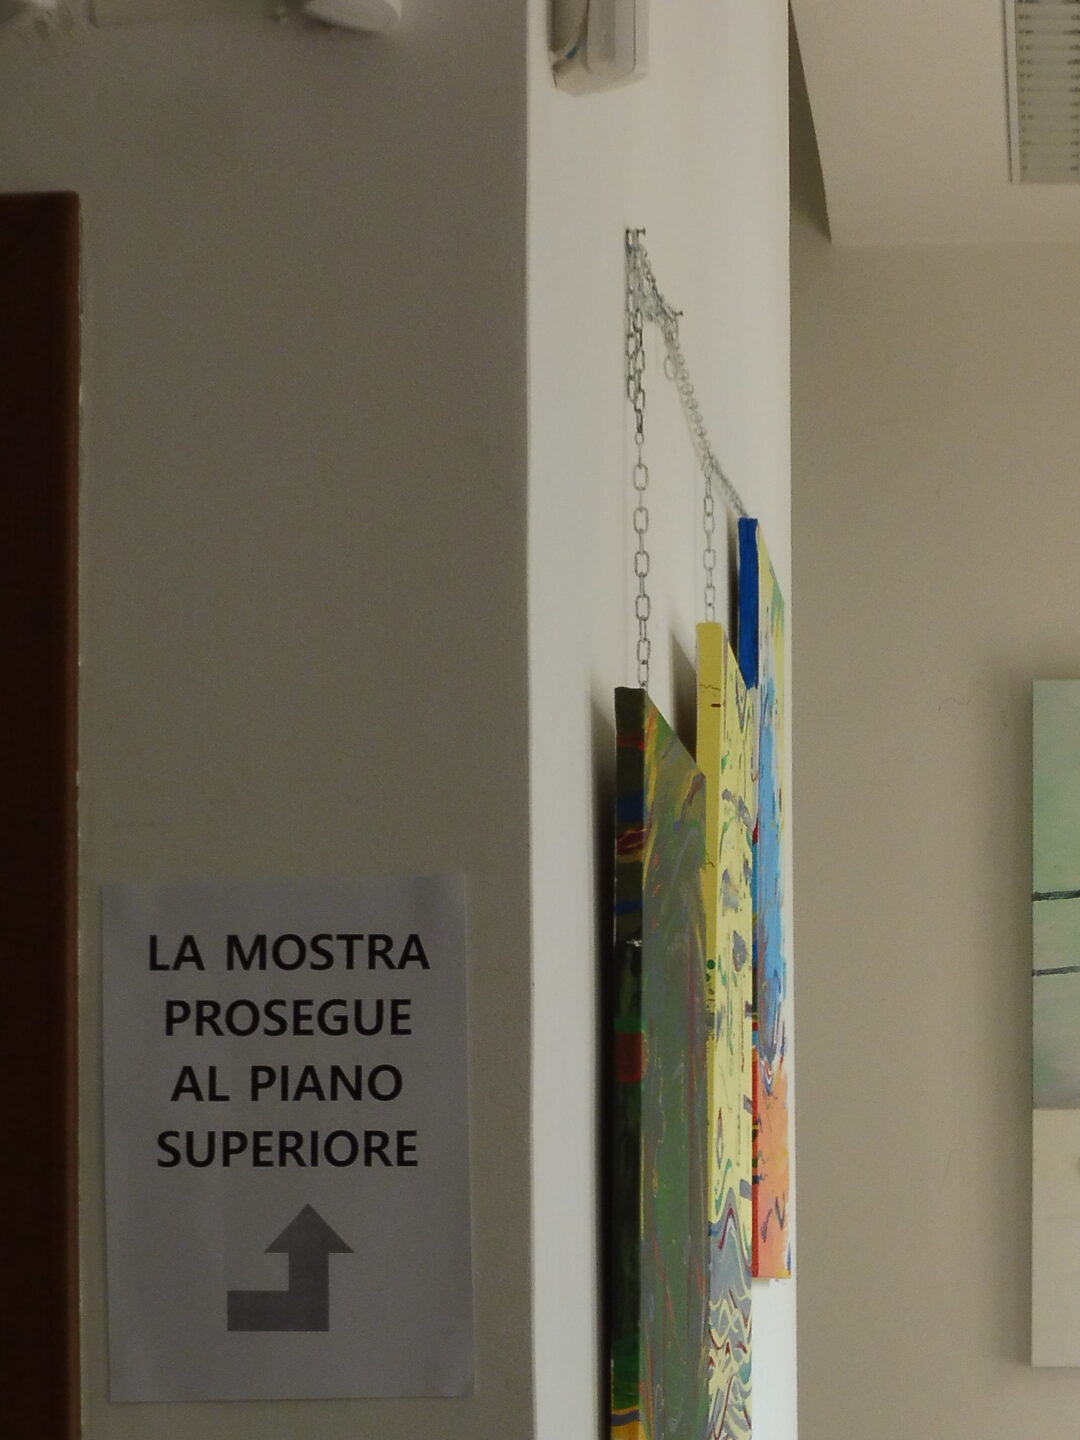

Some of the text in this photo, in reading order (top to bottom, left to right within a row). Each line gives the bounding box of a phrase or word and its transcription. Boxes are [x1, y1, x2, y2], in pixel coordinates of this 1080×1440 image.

[150, 934, 431, 971] LA MOSTRA
[166, 999, 412, 1037] PROSEGUE
[171, 1065, 403, 1102] AL PIANO
[158, 1130, 418, 1168] SUPERIORE
